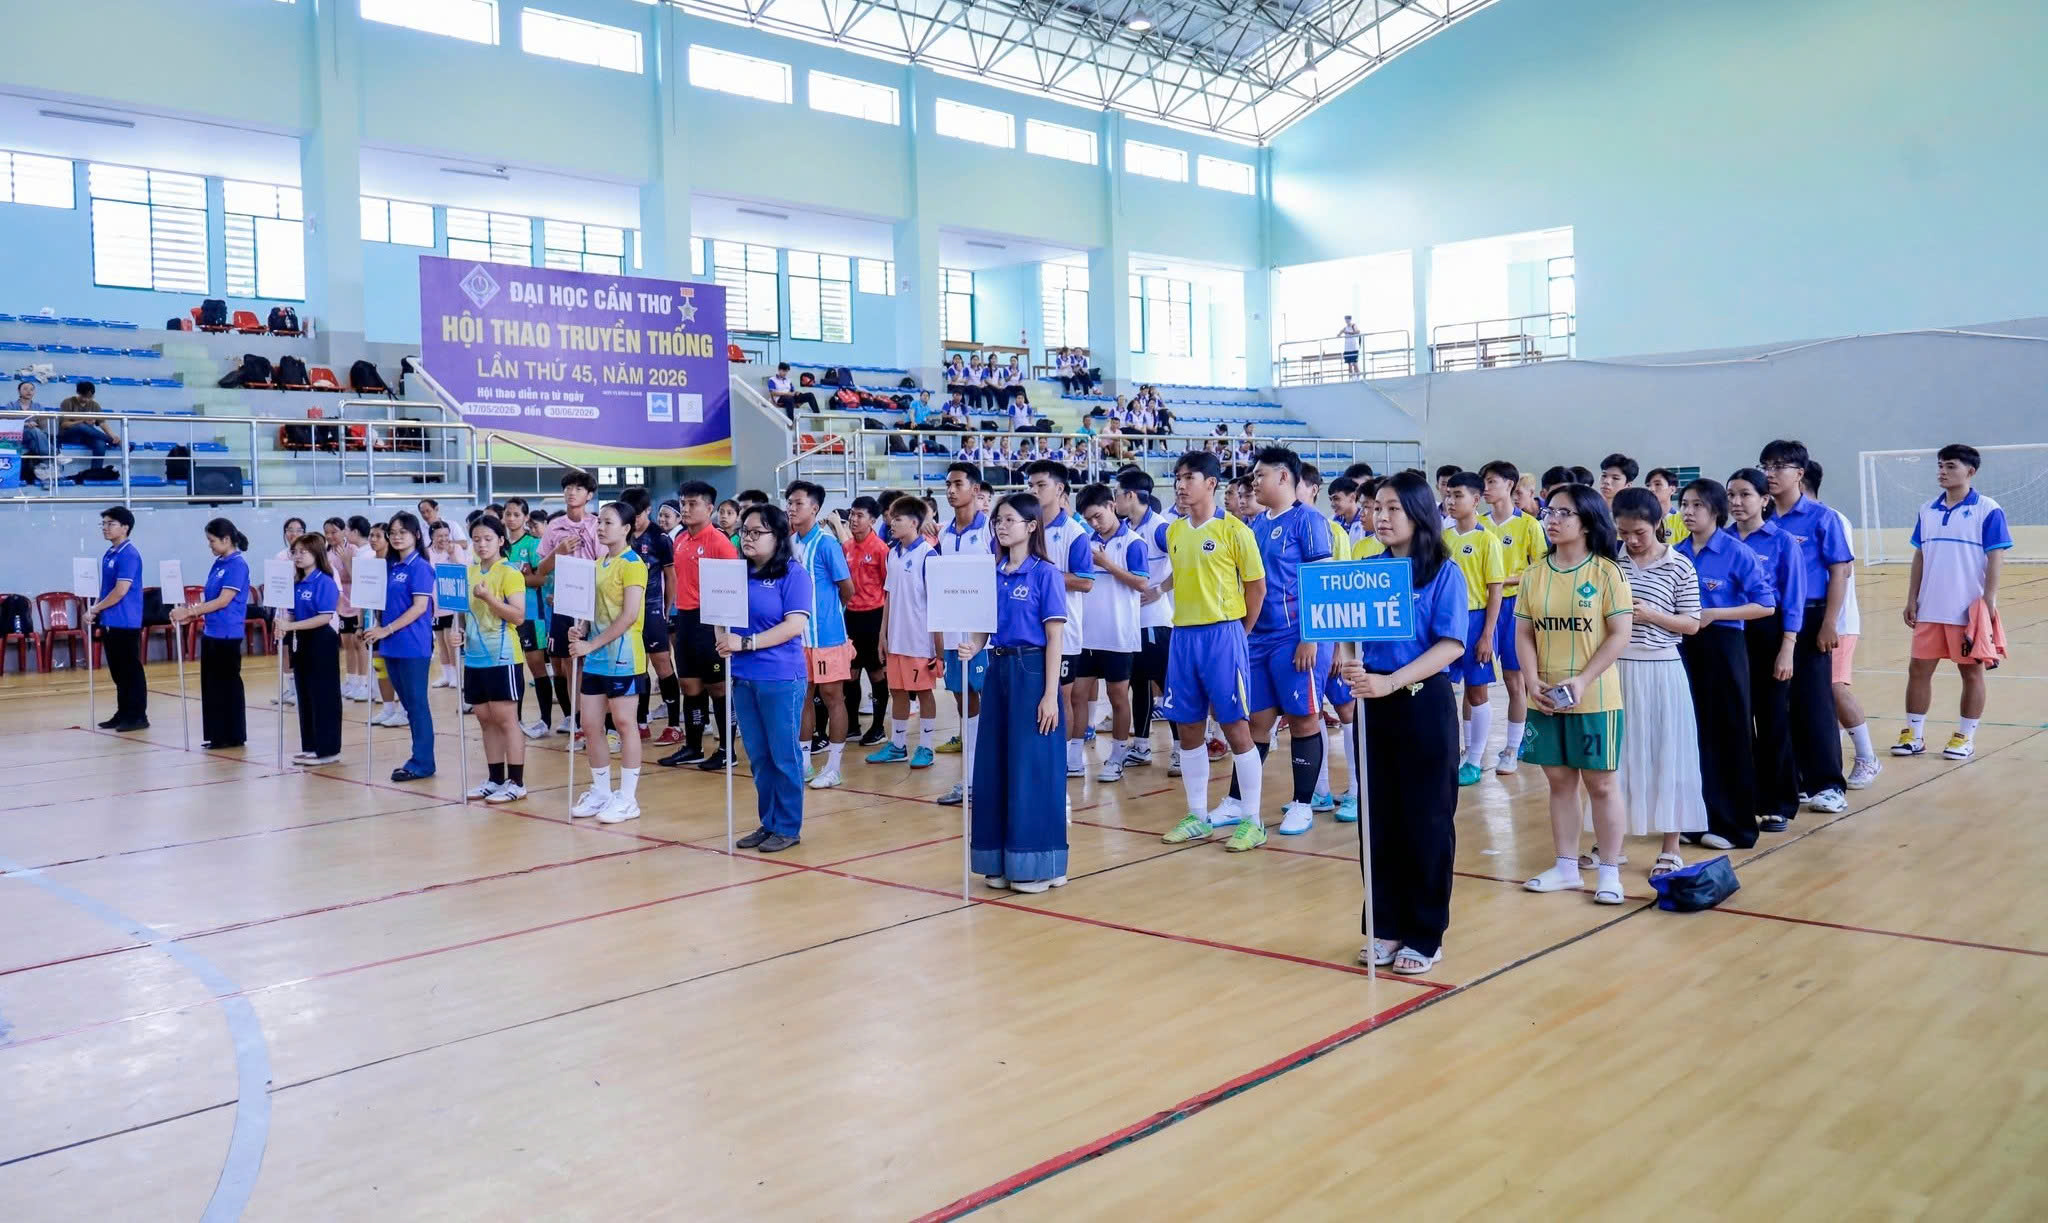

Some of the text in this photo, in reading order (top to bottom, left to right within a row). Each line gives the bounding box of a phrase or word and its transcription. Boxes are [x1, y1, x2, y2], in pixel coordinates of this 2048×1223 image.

[510, 281, 673, 315] ĐẠI HỌC CẦN THƠ
[442, 310, 714, 358] HỘI THAO TRUYỀN THỐNG
[477, 351, 687, 387] LẦN THỨ 45, NĂM 2026
[477, 386, 585, 402] Hội thao diễn ra từ ngày
[468, 404, 595, 417] 17/05/2026 đến 30/06/2026
[1320, 570, 1391, 591] TRƯỜNG
[1311, 592, 1401, 629] KINH TẾ
[1578, 600, 1592, 608] CSE
[818, 660, 826, 675] 11
[913, 669, 920, 683] 7
[1583, 733, 1601, 757] 21
